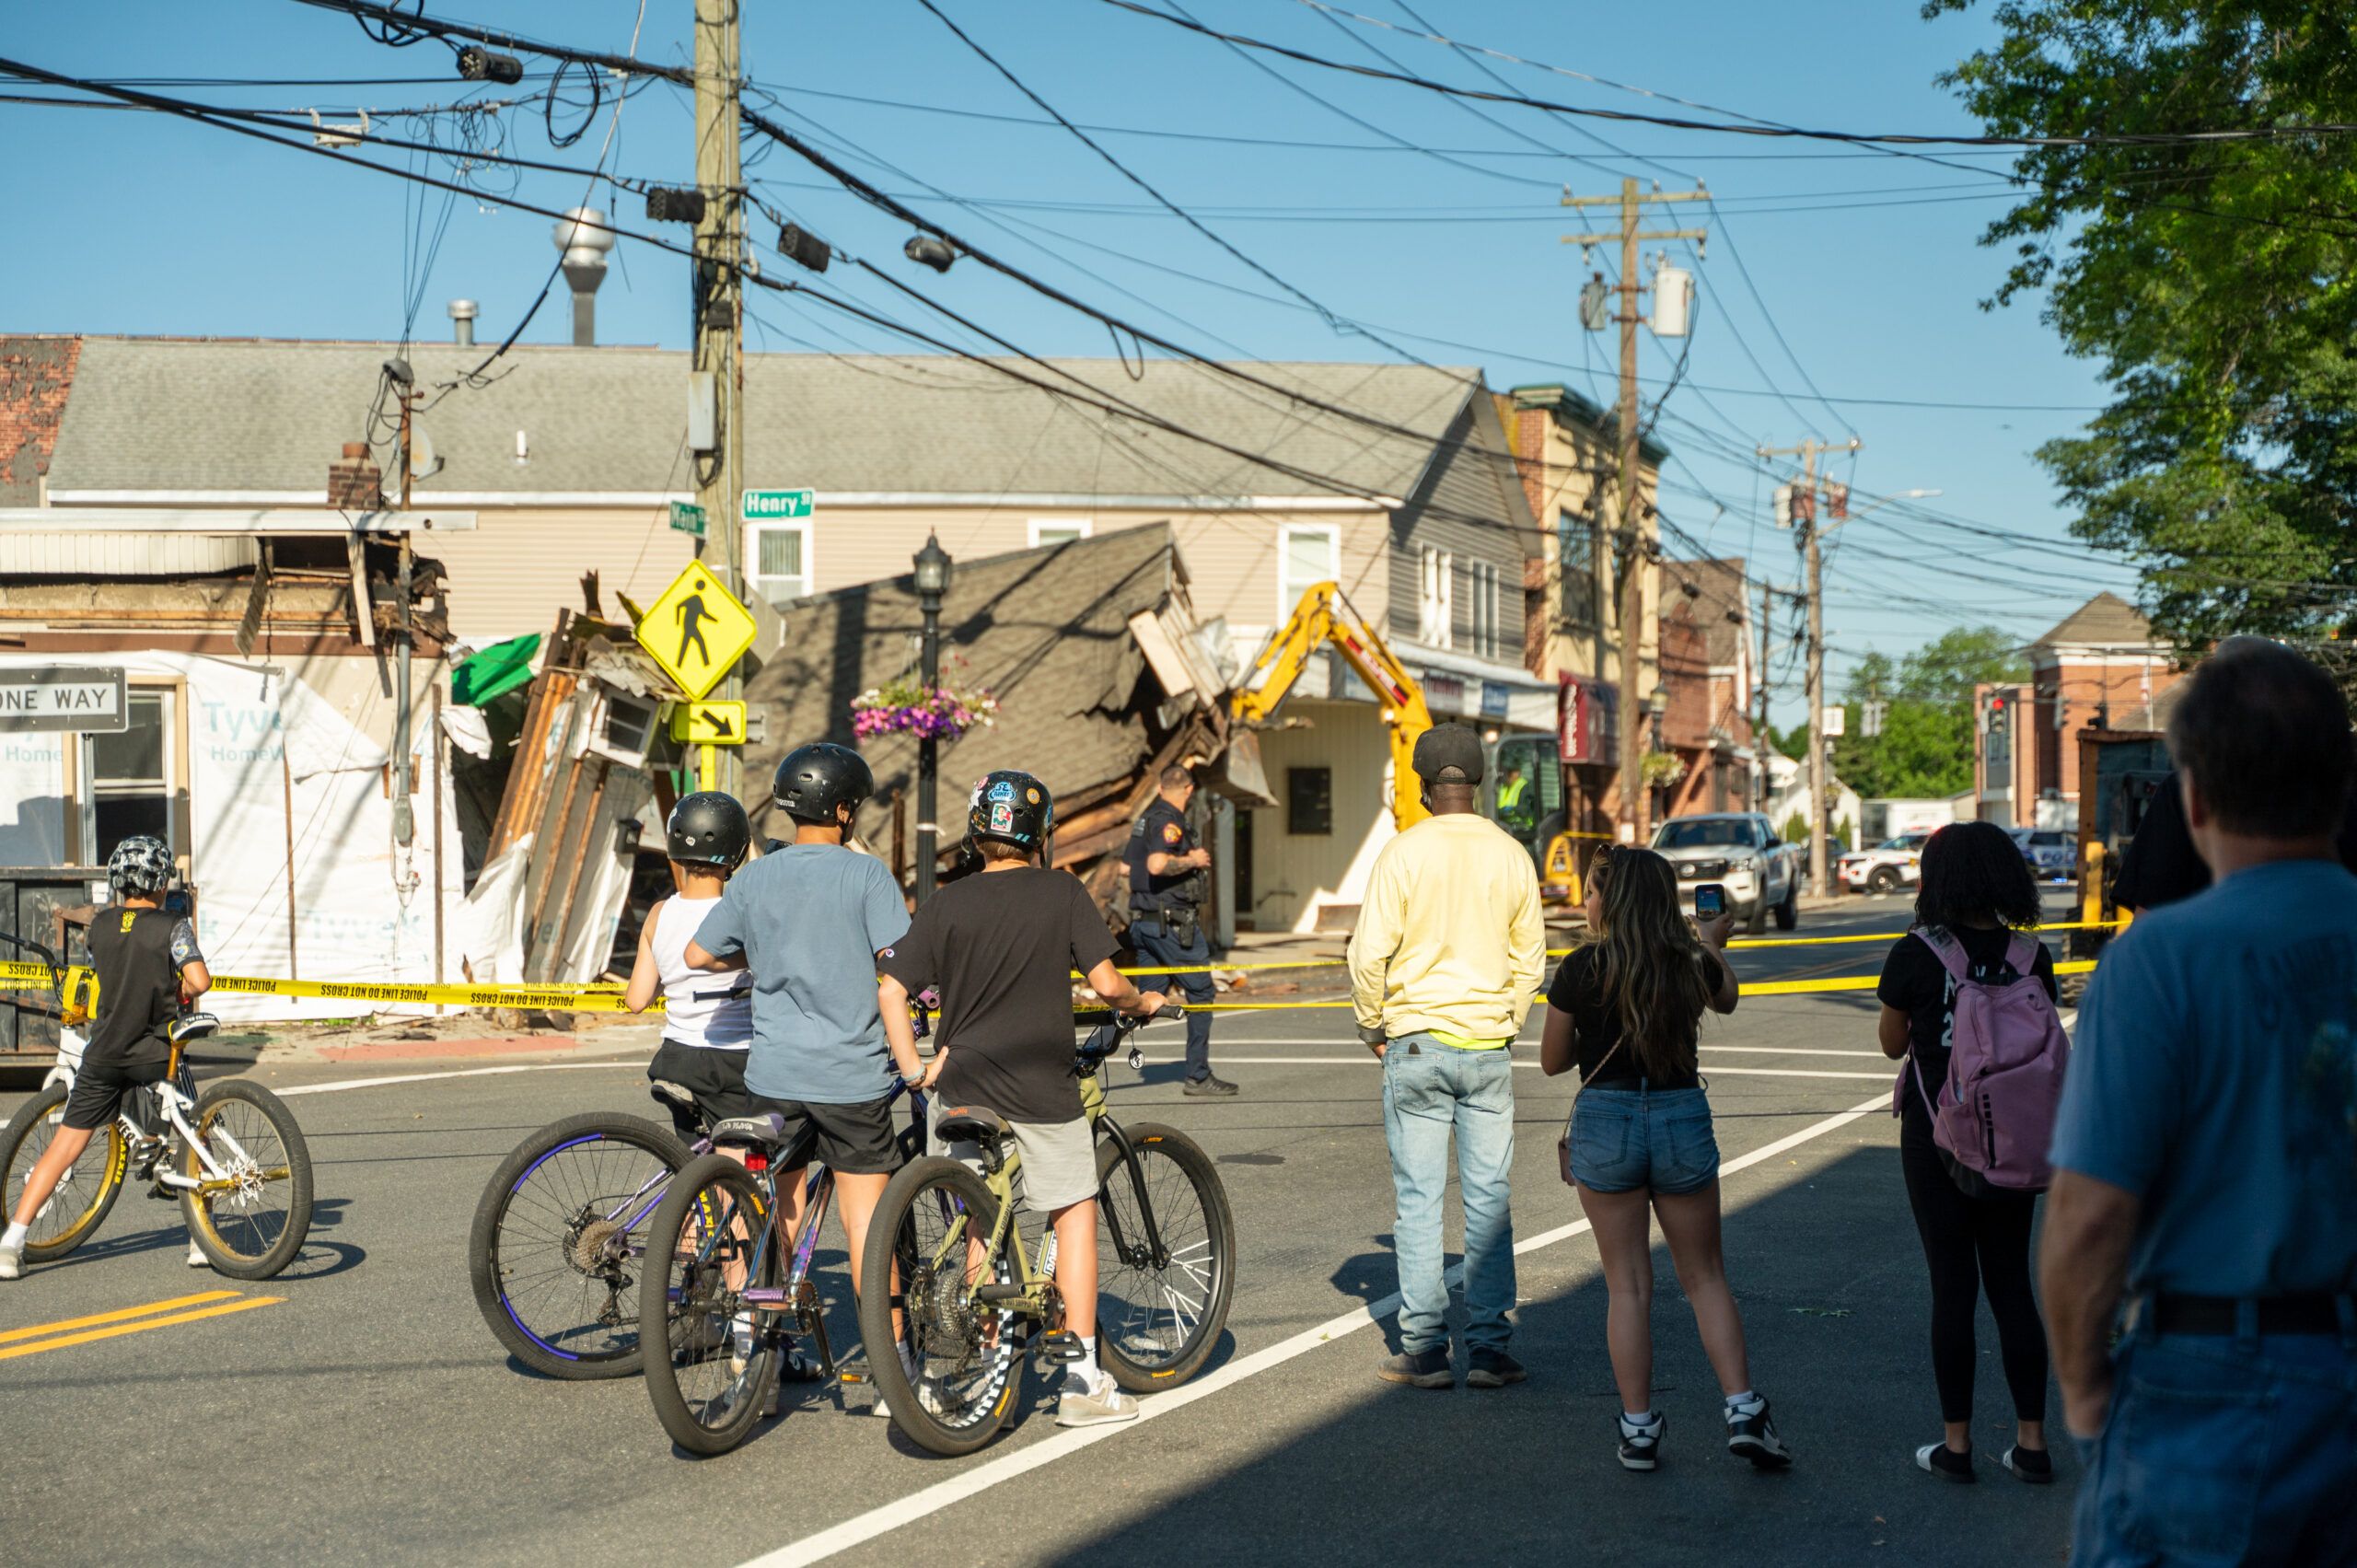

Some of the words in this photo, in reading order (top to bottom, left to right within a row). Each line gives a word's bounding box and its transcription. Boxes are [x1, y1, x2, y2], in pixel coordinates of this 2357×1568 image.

[746, 494, 797, 517] Henry
[670, 505, 698, 530] Main
[55, 689, 107, 709] WAY
[8, 963, 37, 976] CROSS
[215, 978, 227, 989] DO
[229, 979, 247, 991] LINE
[248, 980, 276, 993] POLICE
[321, 983, 349, 996] CROSS
[351, 985, 367, 997] NOT
[368, 987, 380, 998] DO
[381, 988, 399, 1000] LINE
[400, 989, 428, 1001] POLICE
[470, 992, 497, 1004] CROSS
[499, 993, 515, 1005] NOT
[517, 993, 529, 1005] DO
[529, 994, 546, 1005] LINE
[547, 995, 575, 1006] POLICE
